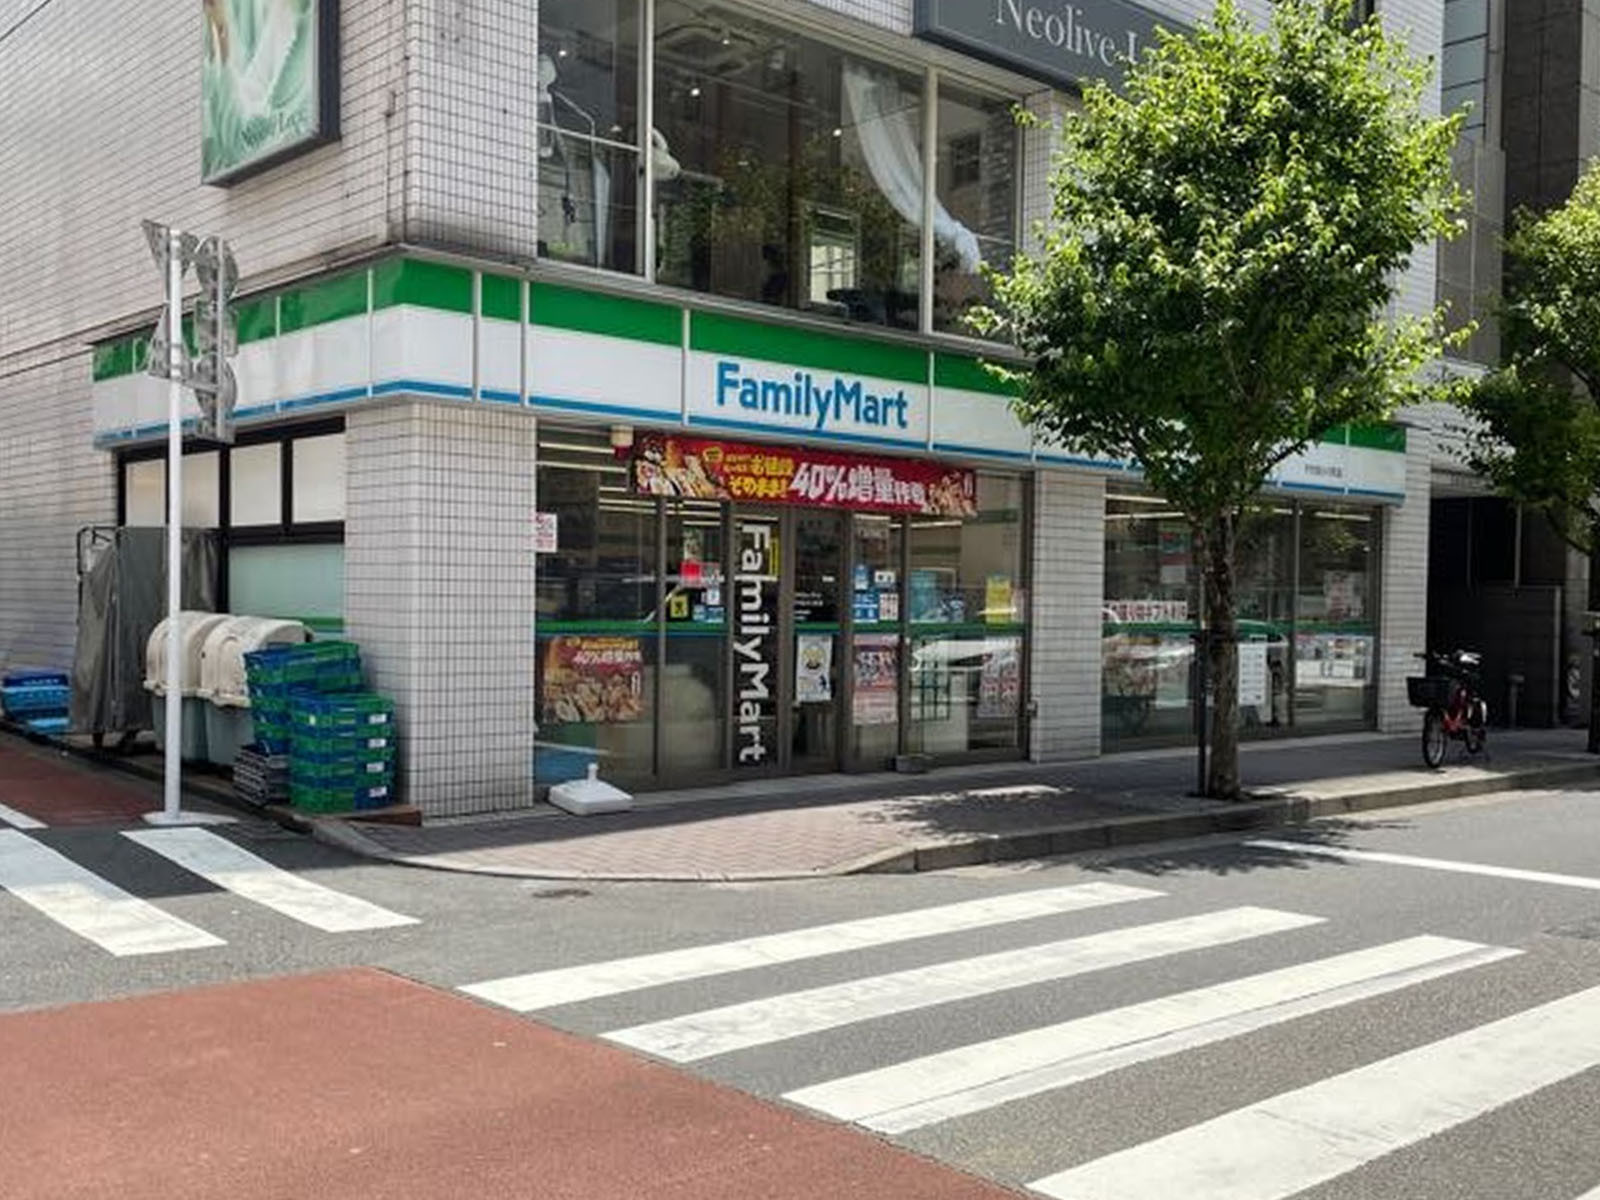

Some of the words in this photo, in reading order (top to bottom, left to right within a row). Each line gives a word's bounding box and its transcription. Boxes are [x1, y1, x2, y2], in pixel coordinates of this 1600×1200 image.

[995, 0, 1116, 68] Neolive
[717, 361, 908, 429] FamilyMart
[733, 524, 771, 762] FamilyMart
